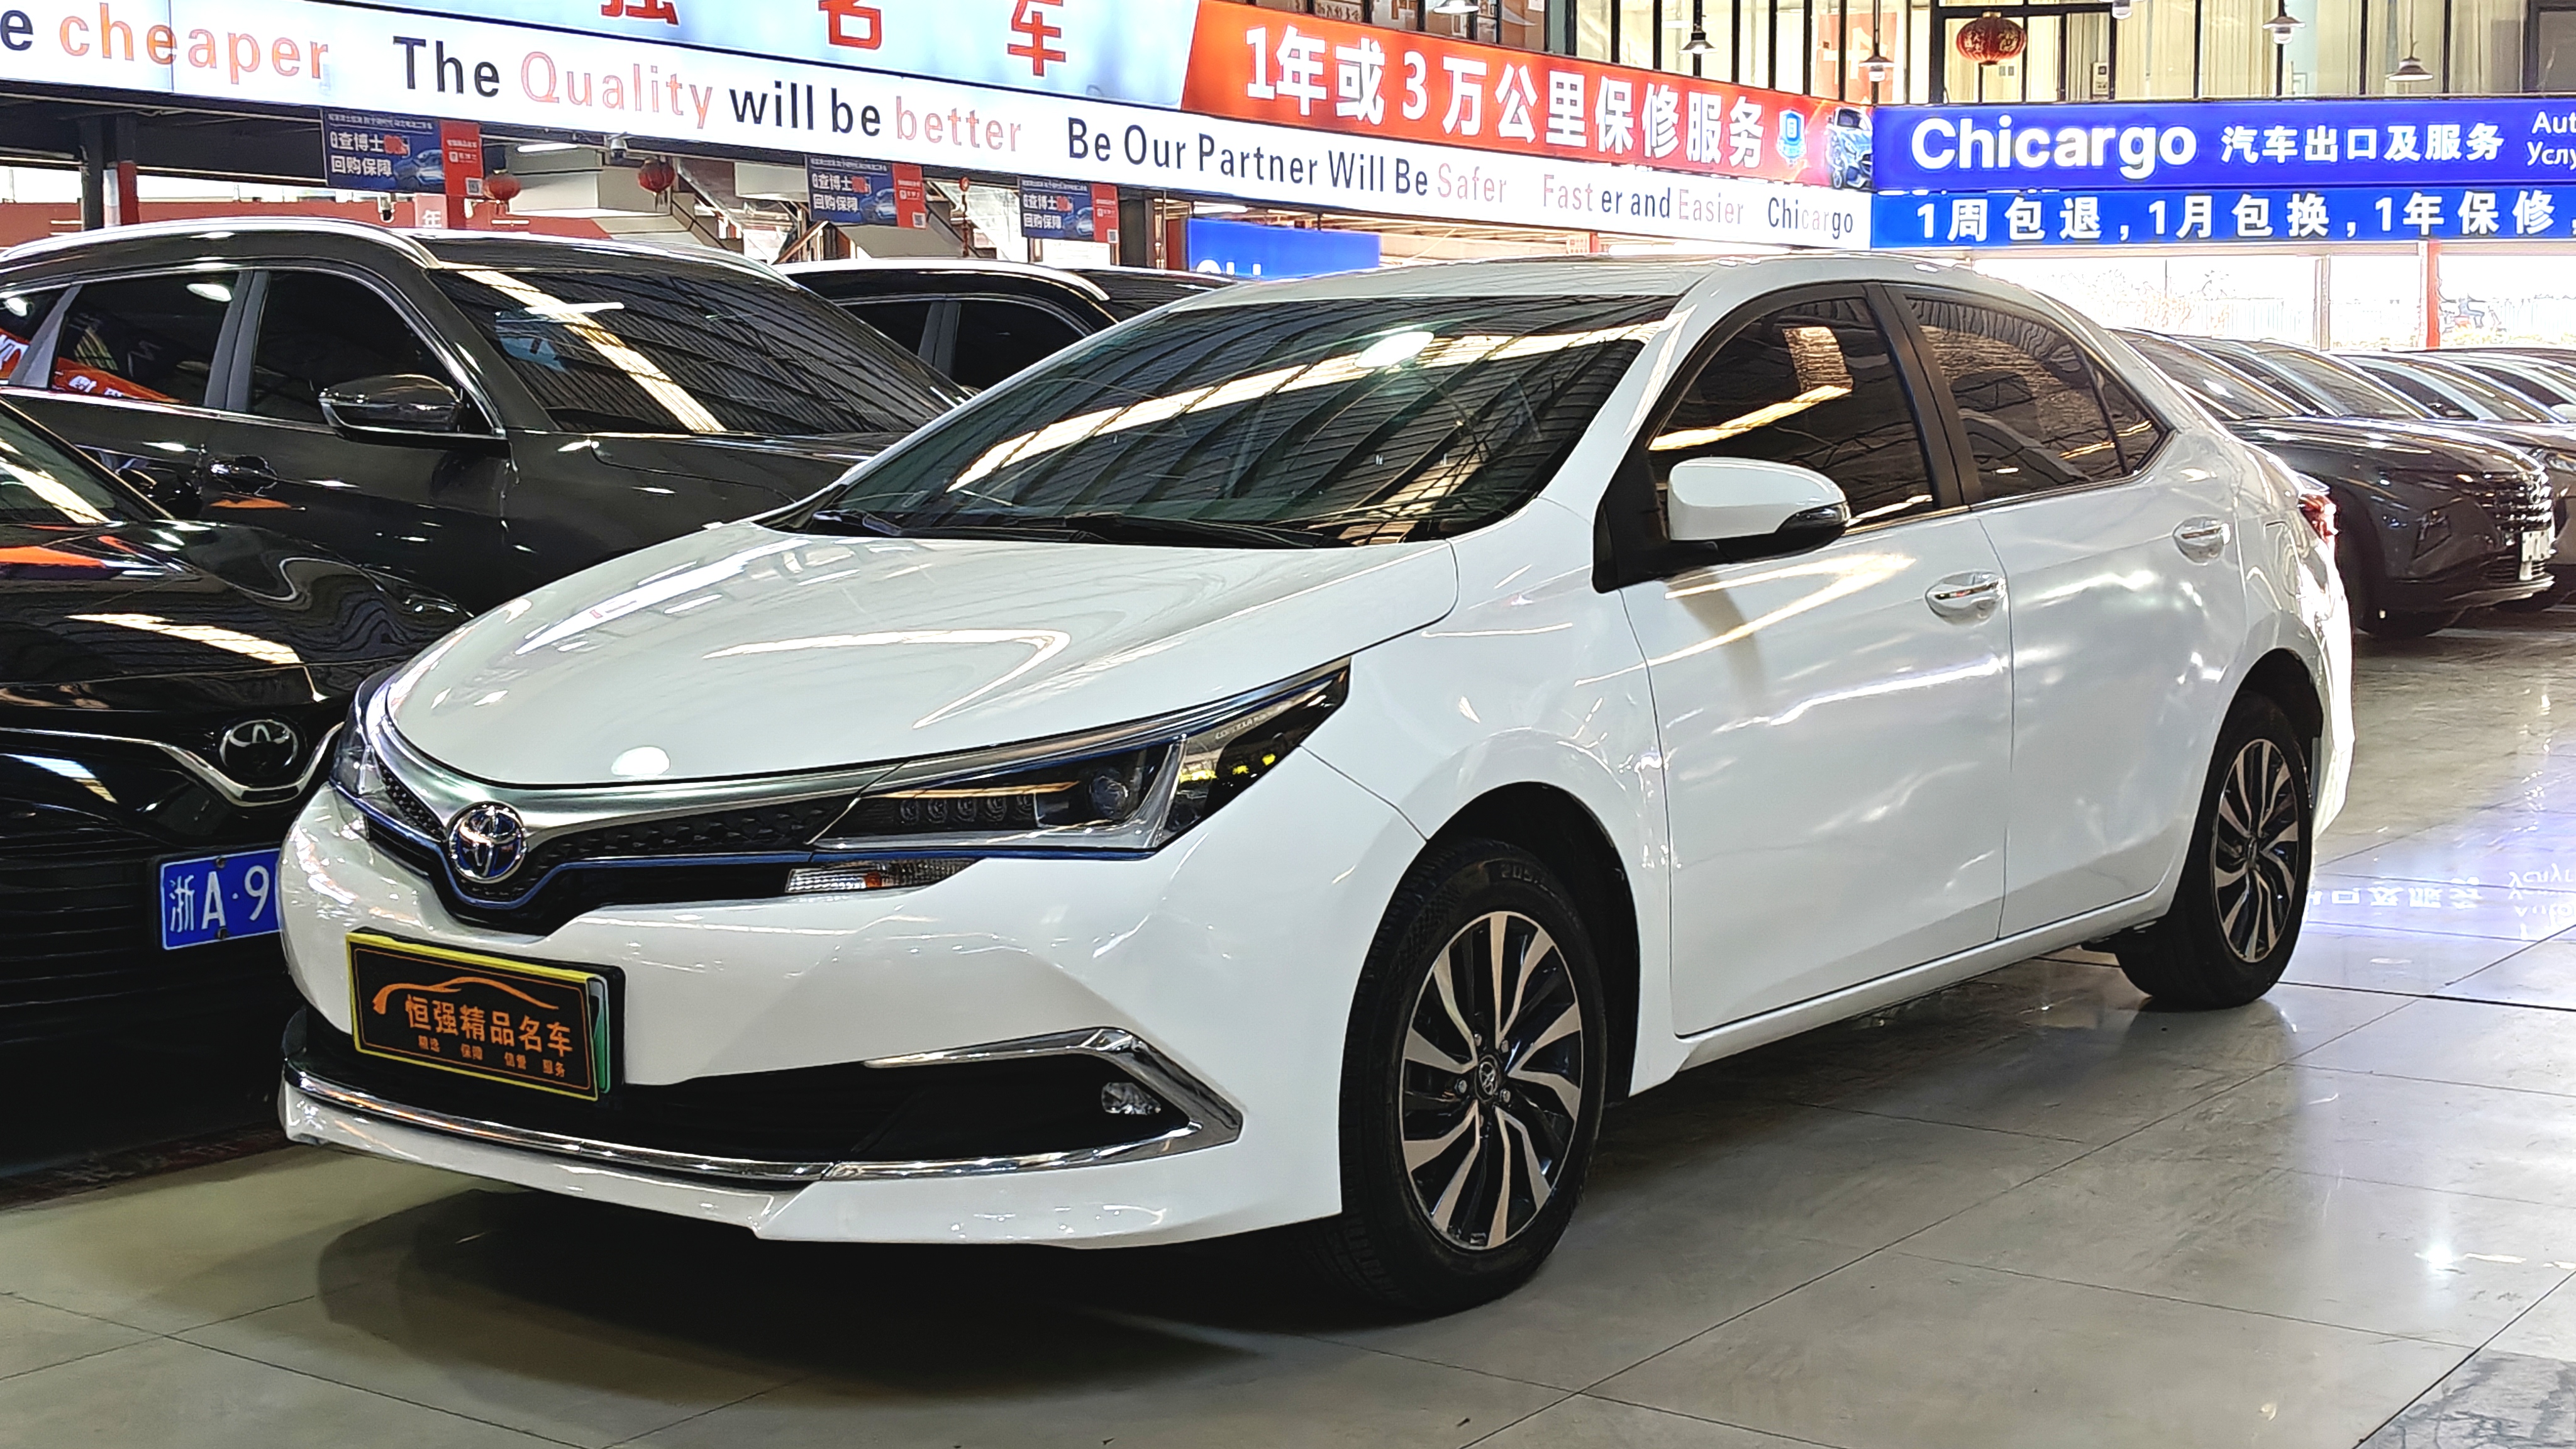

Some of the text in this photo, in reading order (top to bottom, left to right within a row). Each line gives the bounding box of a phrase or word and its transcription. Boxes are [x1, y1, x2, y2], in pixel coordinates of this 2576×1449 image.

[60, 2, 328, 84] cheaper
[393, 36, 500, 97] The
[521, 52, 713, 129] Quality
[729, 80, 814, 131] will
[831, 87, 880, 136] be
[896, 96, 1021, 152] better
[1068, 116, 1111, 162] Be
[1124, 125, 1186, 169] Our
[1199, 133, 1318, 186] Partner
[1328, 150, 1384, 192] Will
[1396, 158, 1428, 196] Be
[1438, 162, 1507, 203] Safer
[1631, 187, 1670, 218] and
[1679, 189, 1744, 225] Easier
[1768, 196, 1853, 240] Chicargo
[1911, 114, 2197, 180] Chicargo
[2221, 123, 2504, 164] 汽车出口及服务
[404, 993, 573, 1057] 恒强精品名车
